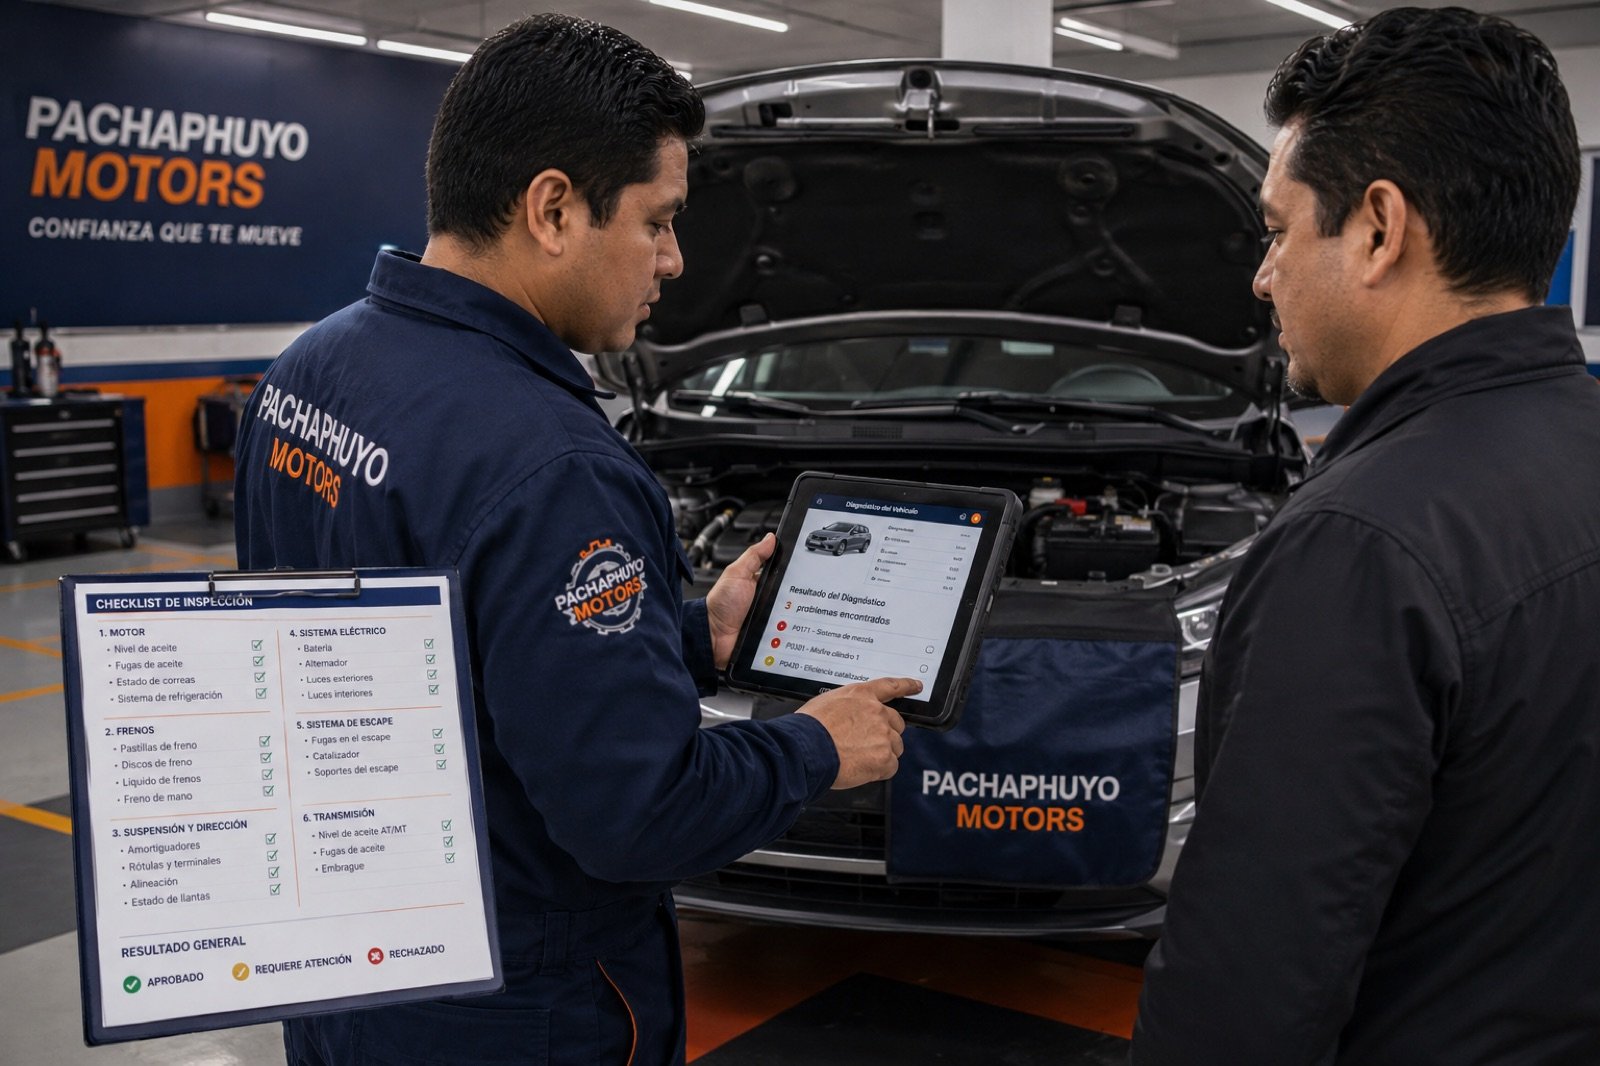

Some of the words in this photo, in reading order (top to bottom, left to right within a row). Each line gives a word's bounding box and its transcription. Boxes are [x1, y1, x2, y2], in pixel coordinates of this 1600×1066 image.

[25, 95, 309, 161] PACHAPHUYO
[30, 147, 266, 208] MOTORS
[28, 216, 154, 242] CONFIANZA
[159, 221, 203, 243] QUE
[207, 223, 233, 244] TE
[236, 224, 302, 246] MUEVE
[257, 384, 389, 486] PACHAPHUYO
[269, 437, 342, 508] MOTORS
[554, 558, 644, 611] PACHAPHUYO
[96, 598, 161, 609] CHECKLIST
[165, 597, 180, 607] DE
[183, 593, 253, 607] INSPECCIÓN
[574, 576, 642, 622] MOTORS
[789, 585, 827, 598] Resultado
[827, 591, 840, 600] del
[841, 593, 886, 607] Diagnóstico
[785, 601, 792, 610] 3
[796, 604, 838, 617] problemas
[839, 611, 891, 626] encontrados
[109, 628, 145, 637] MOTOR
[289, 630, 298, 638] 4.
[299, 628, 338, 637] SISTEMA
[340, 626, 387, 636] ELÉCTRICO
[114, 643, 136, 653] Nivel
[138, 643, 149, 653] de
[151, 643, 177, 652] aceite
[115, 661, 142, 672] Fugas
[144, 660, 155, 669] de
[157, 659, 183, 668] aceite
[116, 677, 147, 686] Estado
[149, 676, 160, 685] de
[162, 676, 195, 685] correas
[306, 675, 331, 684] Luces
[333, 674, 373, 683] exteriores
[118, 693, 153, 703] Sistema
[155, 693, 167, 702] de
[168, 691, 223, 702] refrigeración
[307, 690, 332, 699] Luces
[334, 689, 373, 698] interiores
[296, 721, 304, 729] 5.
[306, 720, 345, 729] SISTEMA
[347, 719, 358, 727] DE
[360, 717, 393, 726] ESCAPE
[105, 728, 114, 736] 2.
[116, 726, 154, 735] FRENOS
[311, 737, 337, 746] Fugas
[351, 734, 359, 742] el
[361, 734, 391, 743] escape
[120, 742, 157, 753] Pastillas
[159, 742, 171, 751] de
[173, 741, 197, 751] freno
[312, 751, 360, 760] Catalizador
[121, 759, 153, 769] Discos
[155, 759, 166, 768] de
[168, 758, 193, 767] freno
[314, 767, 352, 777] Soportes
[354, 765, 367, 774] del
[369, 764, 398, 774] escape
[158, 776, 171, 784] de
[173, 775, 201, 784] frenos
[921, 769, 1120, 801] PACHAPHUYO
[124, 794, 151, 804] Freno
[152, 793, 165, 802] de
[167, 792, 193, 801] mano
[303, 814, 311, 822] 6.
[313, 808, 375, 821] TRANSMISIÓN
[956, 803, 1085, 832] MOTORS
[112, 829, 121, 837] 3.
[123, 823, 185, 837] SUSPENSIÓN
[188, 824, 195, 832] Y
[196, 820, 247, 832] DIRECCIÓN
[318, 830, 339, 839] Nivel
[341, 829, 352, 838] de
[354, 827, 379, 836] aceite
[380, 824, 407, 834] AT/MT
[128, 842, 201, 854] Amortiguadores
[320, 848, 345, 857] Fugas
[347, 845, 358, 854] de
[360, 844, 385, 853] aceite
[129, 861, 164, 871] Rótulas
[166, 862, 172, 871] y
[174, 857, 221, 868] terminales
[321, 862, 365, 873] Embrague
[130, 878, 178, 889] Alineación
[131, 896, 165, 907] Estado
[166, 894, 178, 904] de
[180, 892, 211, 902] llantas
[121, 941, 191, 958] RESULTADO
[193, 936, 246, 951] GENERAL
[389, 944, 445, 959] RECHAZADO
[255, 960, 302, 975] REQUIERE
[304, 954, 352, 970] ATENCIÓN
[147, 972, 204, 988] APROBADO
